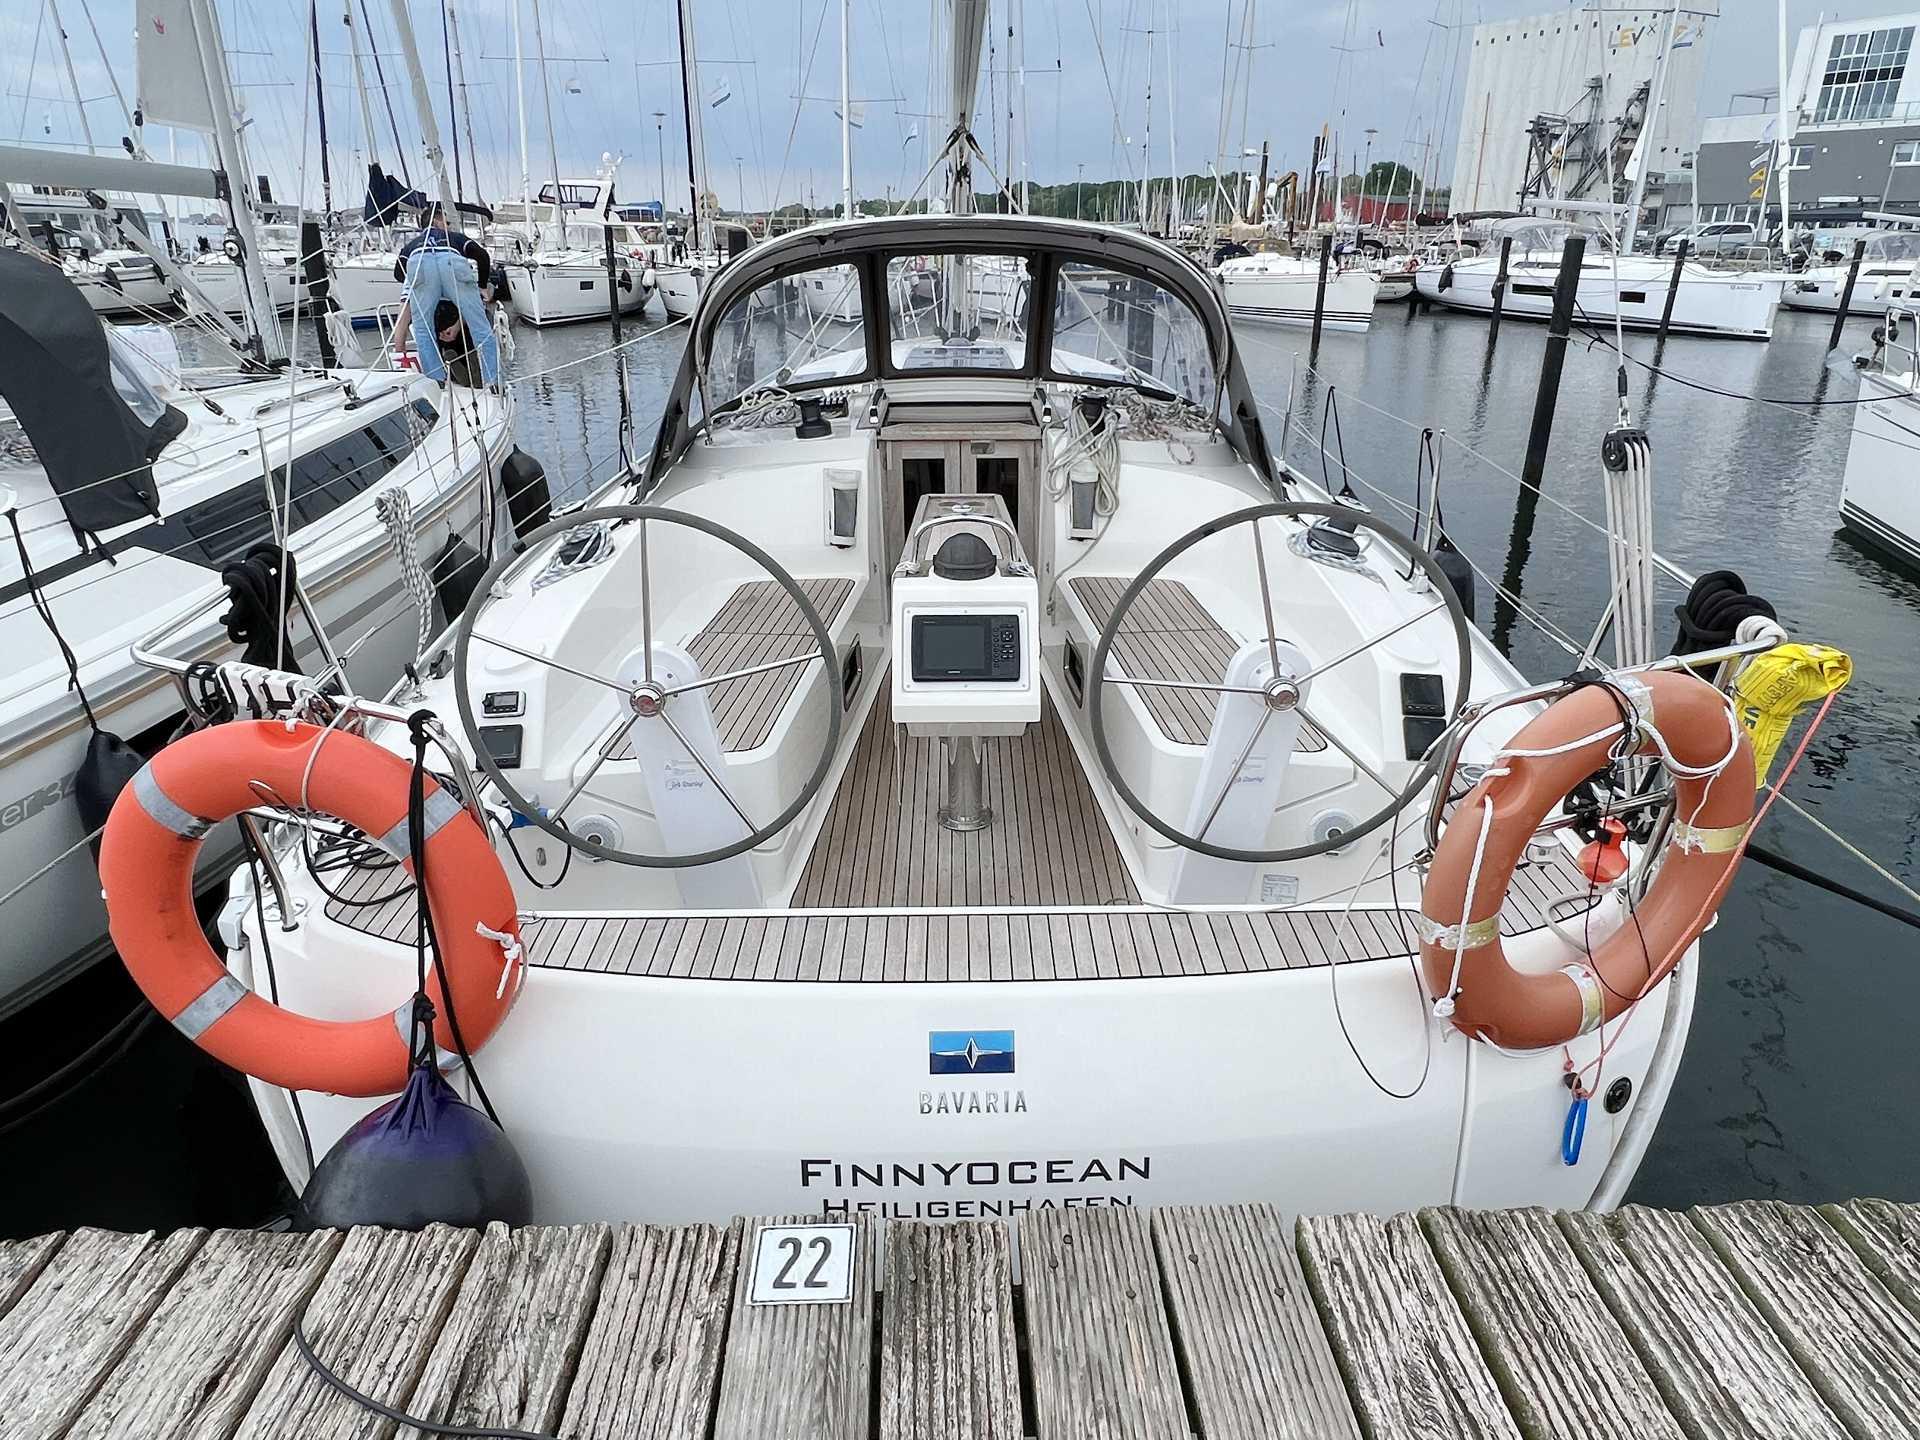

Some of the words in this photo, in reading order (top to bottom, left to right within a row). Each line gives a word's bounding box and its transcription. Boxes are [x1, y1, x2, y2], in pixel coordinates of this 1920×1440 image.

[919, 1090, 1028, 1115] BAVARIA
[800, 1156, 1151, 1188] FINNYOCEAN
[772, 1236, 832, 1289] 22
